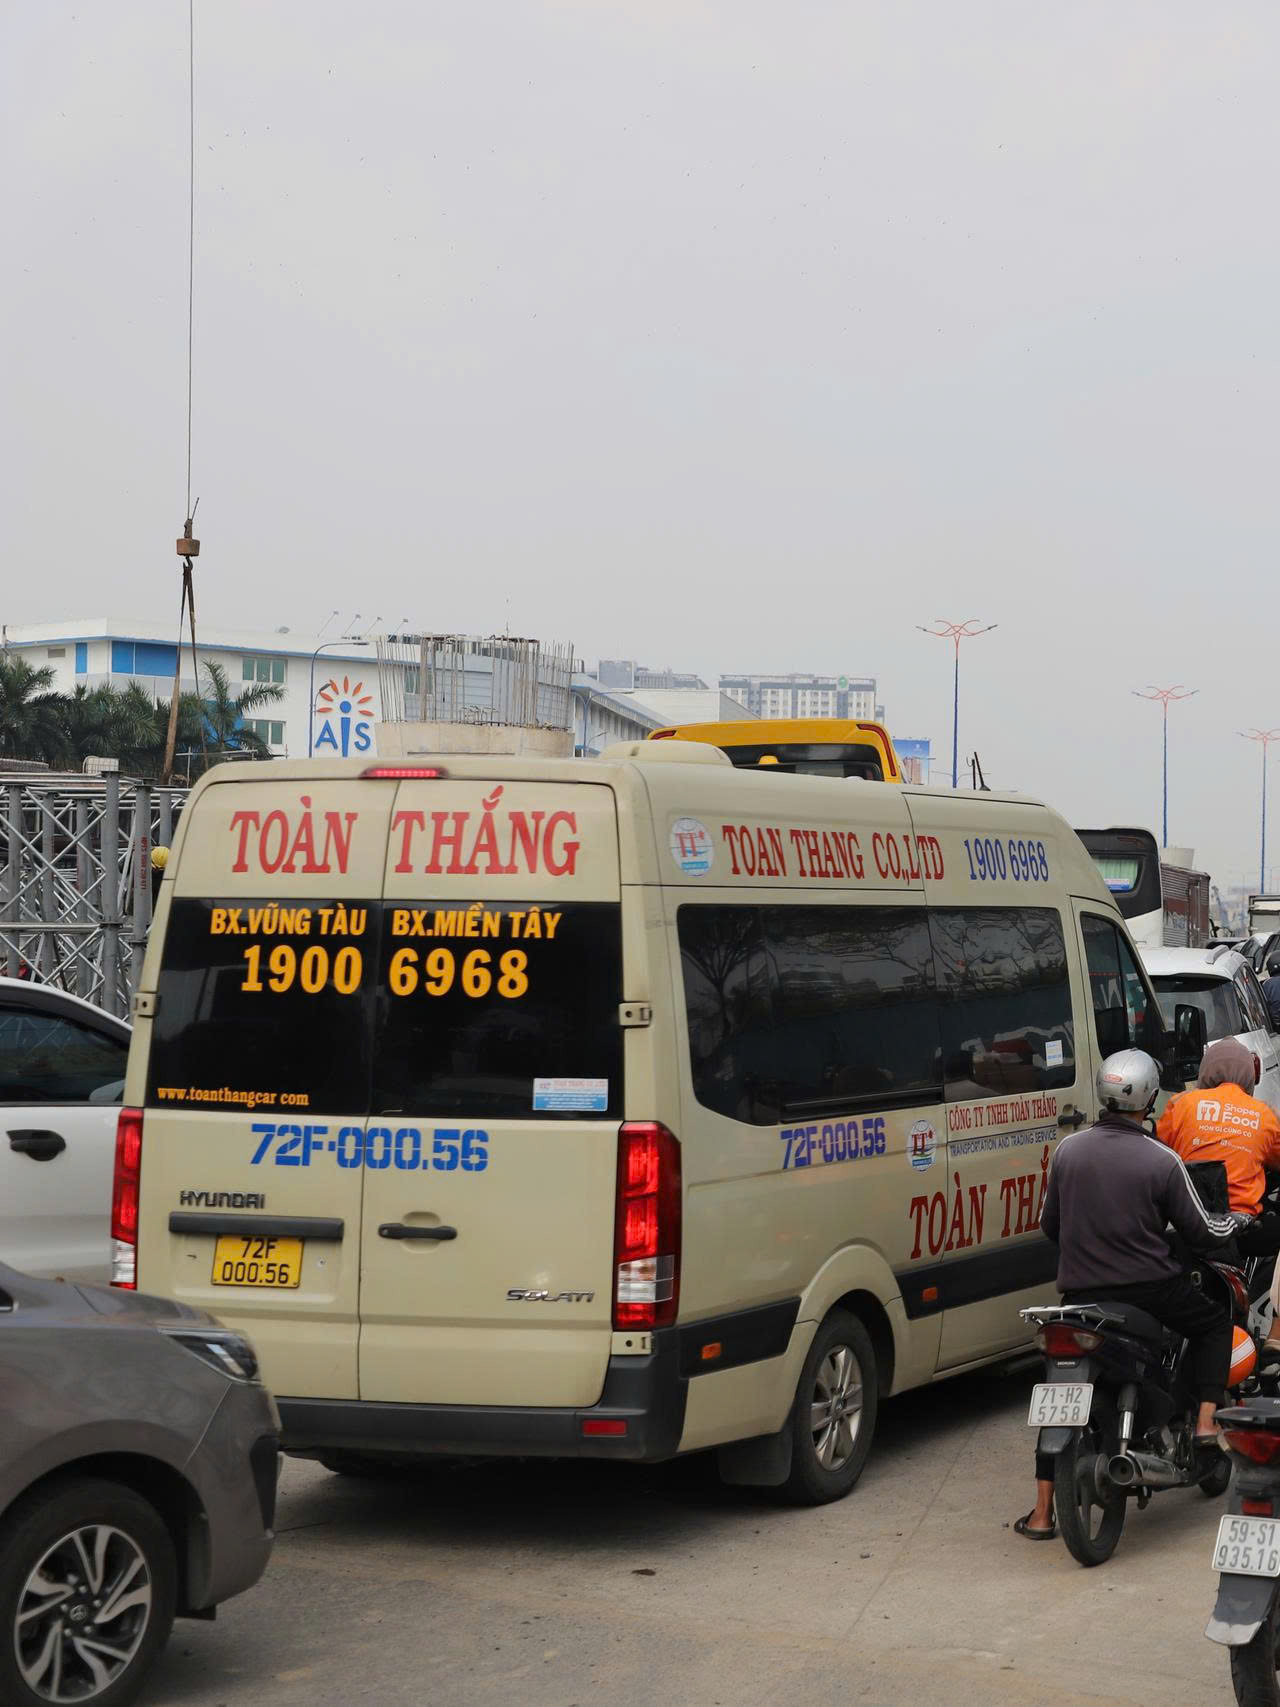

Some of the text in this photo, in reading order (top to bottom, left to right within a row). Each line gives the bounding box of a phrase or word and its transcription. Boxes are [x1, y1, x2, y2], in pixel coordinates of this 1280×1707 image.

[230, 796, 358, 874] TOÀN
[392, 785, 580, 876] THẮNG
[722, 825, 787, 877] TOAN
[790, 829, 864, 879] THANG
[964, 838, 1049, 882] 1900 6968
[210, 902, 367, 936] BX.VŨNG TÀU
[392, 902, 562, 939] BX.MIỀN TÂY
[241, 945, 363, 994] 1900
[389, 948, 529, 998] 6968
[949, 1091, 1057, 1131] CÔNG TY TNHH TOÀN THẮNG
[1222, 1111, 1259, 1130] Food
[251, 1123, 489, 1171] 72F-000.56
[780, 1117, 886, 1169] 72F-000.56
[998, 1136, 1010, 1149] AND
[180, 1190, 265, 1209] HYUNDAI
[909, 1145, 1050, 1259] TOÀN THẮ
[241, 1238, 276, 1259] 72F
[222, 1263, 290, 1284] 000.56
[505, 1288, 595, 1303] SOLATI
[1041, 1387, 1083, 1405] 71-H2
[1038, 1405, 1080, 1422] 5758
[1229, 1520, 1276, 1546] 59-S1
[1217, 1545, 1279, 1571] 935.16
